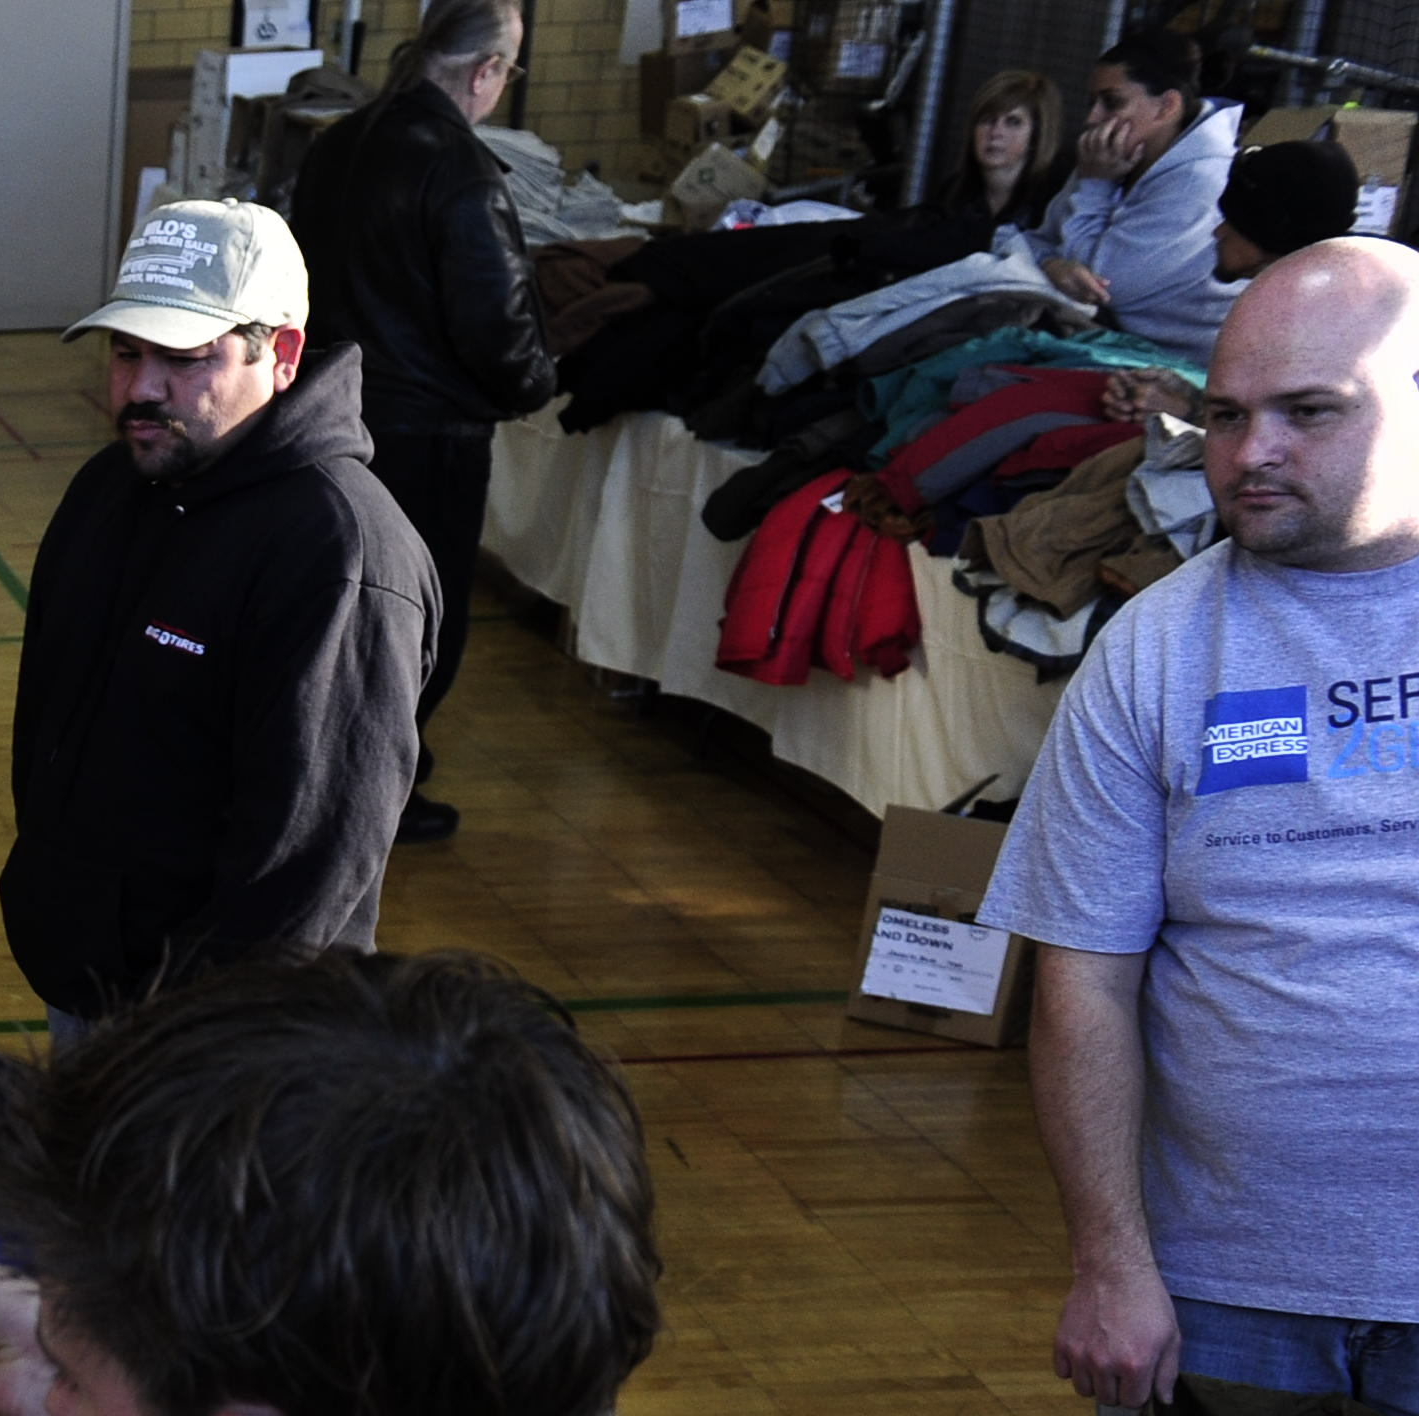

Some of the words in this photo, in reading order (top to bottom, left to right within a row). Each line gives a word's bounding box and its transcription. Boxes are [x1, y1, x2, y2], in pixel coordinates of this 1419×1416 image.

[183, 239, 218, 255] SALES
[144, 272, 194, 290] WYOMING
[169, 634, 206, 656] TIRES
[1206, 718, 1301, 742] MERICAN
[1216, 738, 1310, 761] EXPRESS
[1205, 832, 1260, 848] Service
[1266, 832, 1282, 844] to
[882, 914, 950, 935] OMELESS
